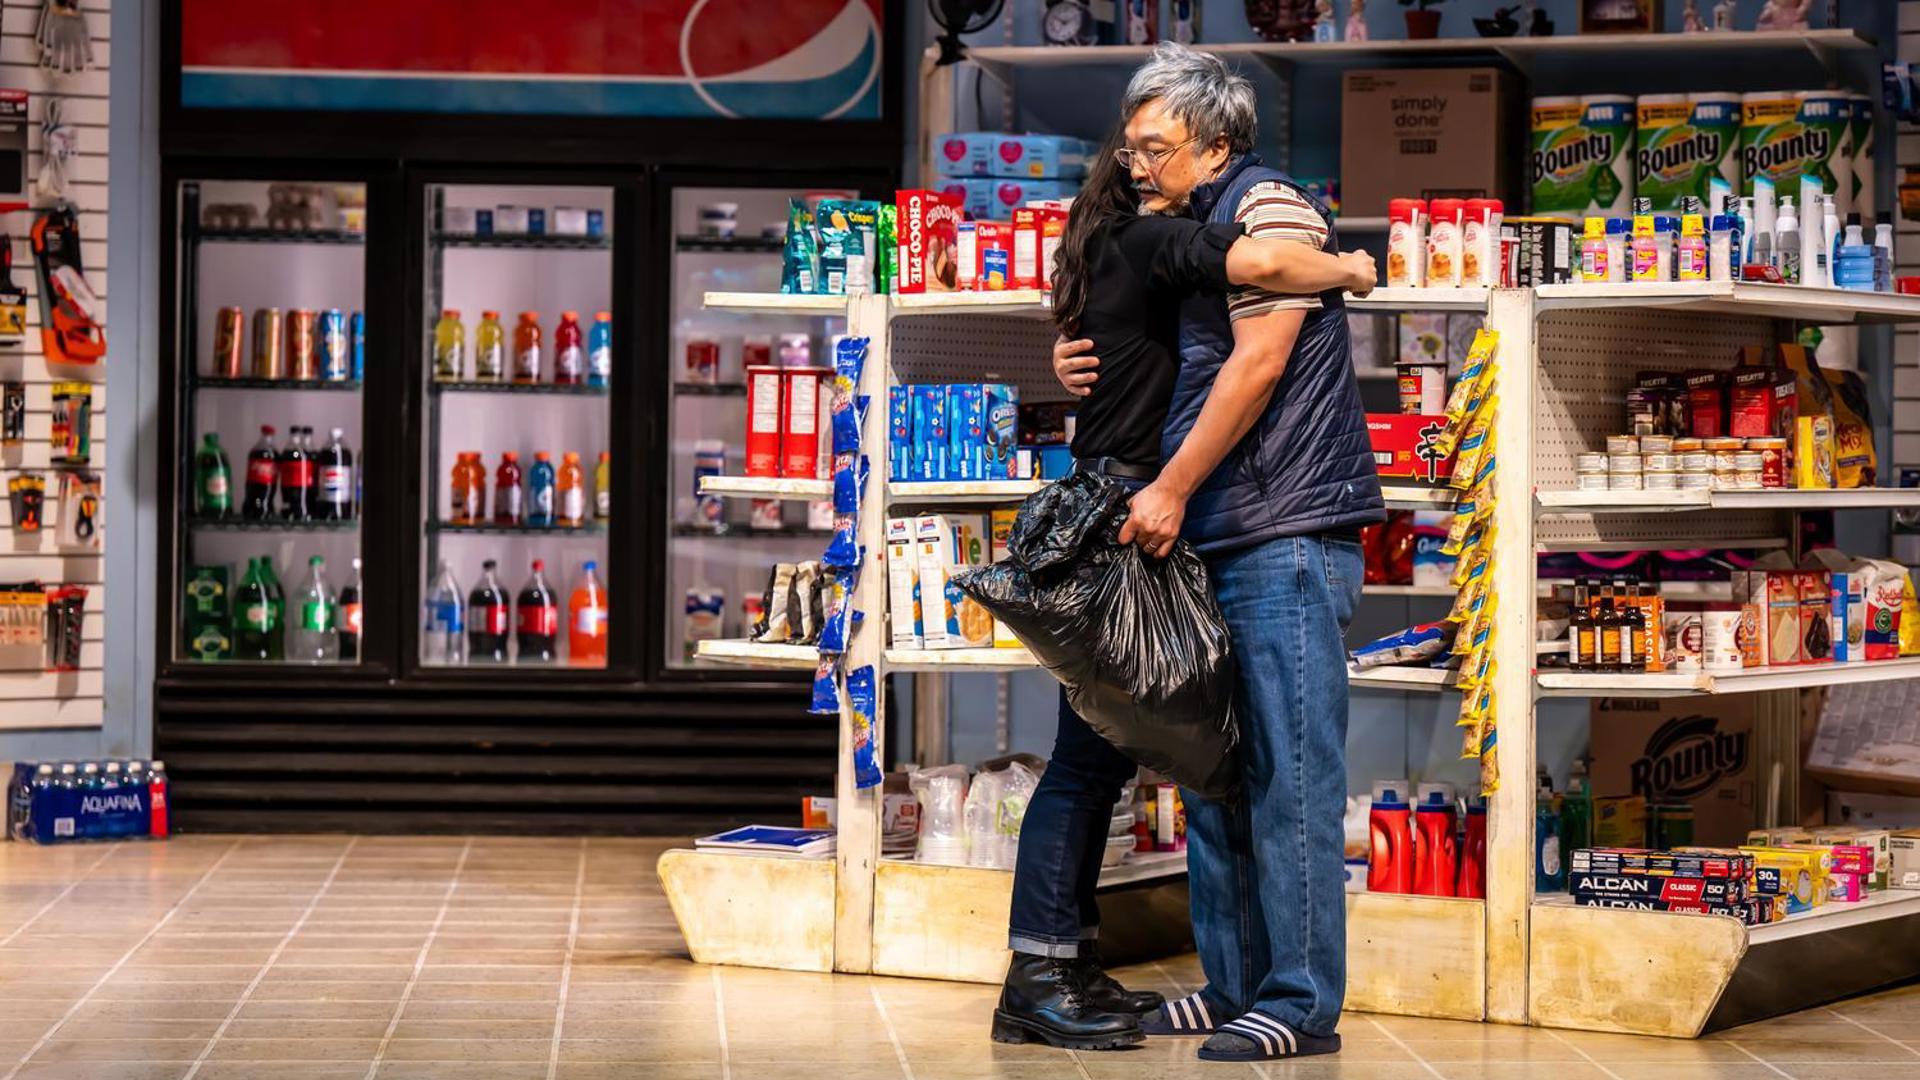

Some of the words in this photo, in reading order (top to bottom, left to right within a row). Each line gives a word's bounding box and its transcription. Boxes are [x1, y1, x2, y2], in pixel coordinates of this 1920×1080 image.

[1391, 95, 1448, 113] simply
[1395, 113, 1440, 128] done
[1532, 133, 1613, 185] Bounty
[1638, 130, 1720, 184] Bounty
[1743, 128, 1829, 181] Bounty
[1641, 604, 1655, 664] TABASCO
[1630, 728, 1746, 806] Bounty
[80, 793, 143, 815] AQUAFINA
[1578, 876, 1649, 893] ALCAN
[1669, 882, 1697, 893] CLASSIC
